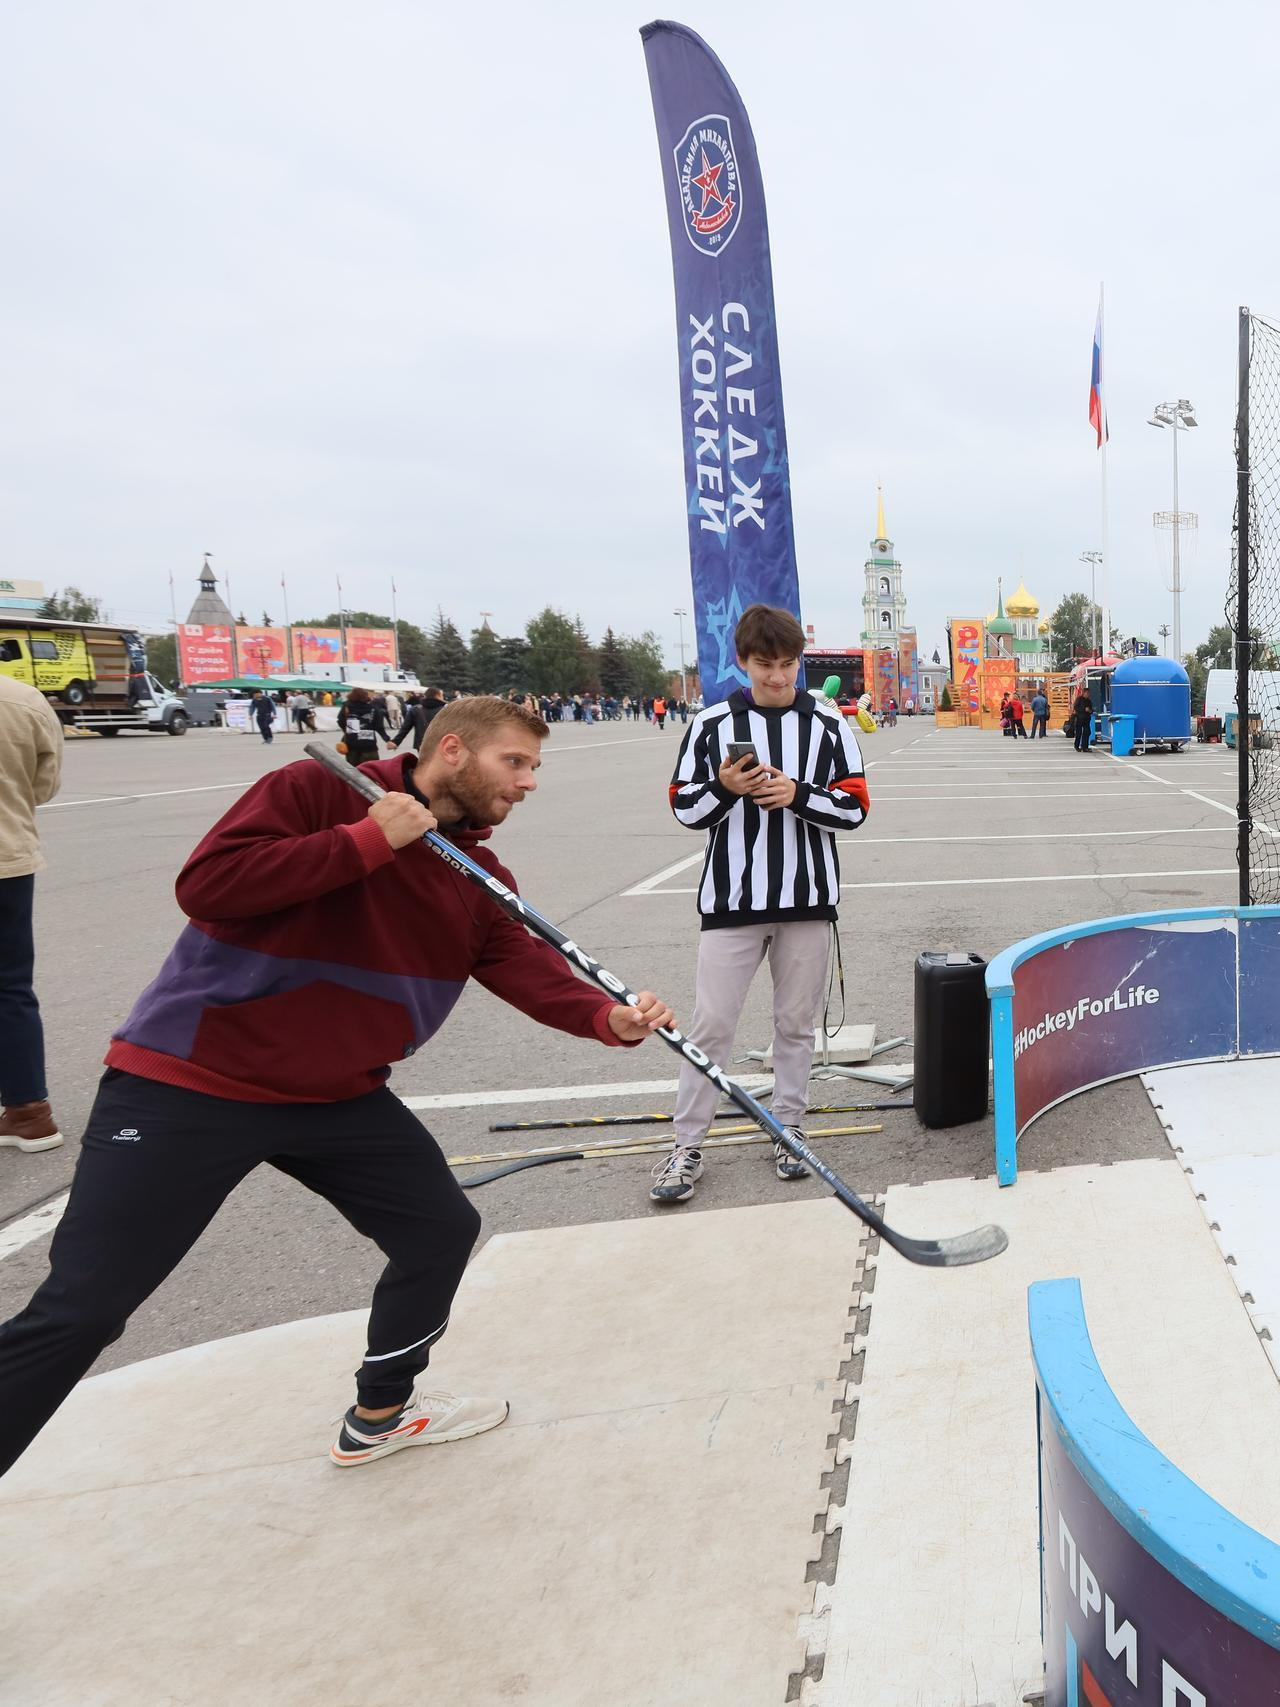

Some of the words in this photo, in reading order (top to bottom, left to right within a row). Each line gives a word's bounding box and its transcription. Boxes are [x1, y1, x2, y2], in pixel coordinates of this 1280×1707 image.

[681, 134, 700, 213] АКАДЕМИЯ
[699, 128, 736, 191] МИХАЙЛОВА
[690, 313, 730, 534] ХОККЕЙ
[722, 302, 765, 530] СЛЕДЖ
[423, 836, 472, 878] eebok
[561, 940, 734, 1096] Rebok
[1014, 985, 1160, 1062] #HockeyForLife
[1058, 1510, 1138, 1688] ПРИ
